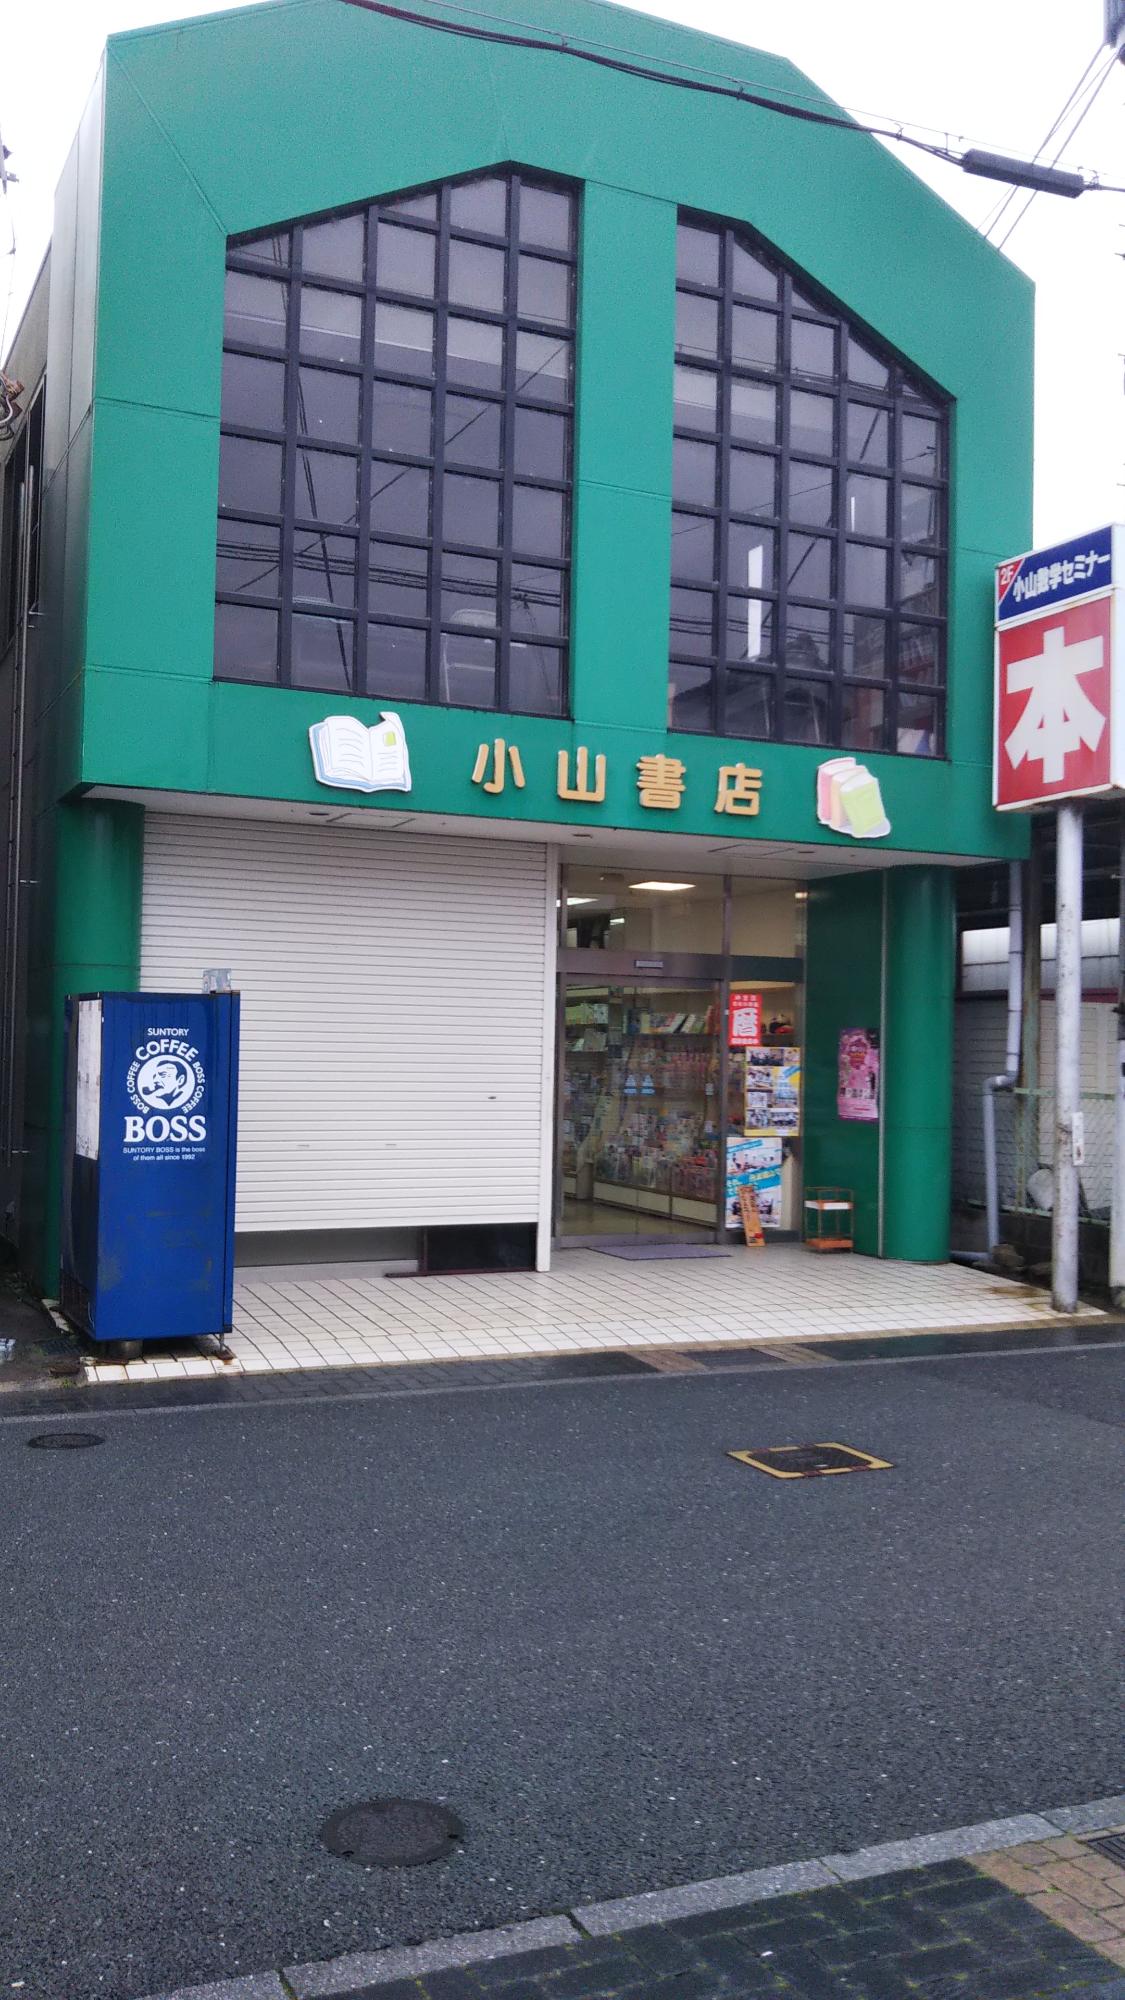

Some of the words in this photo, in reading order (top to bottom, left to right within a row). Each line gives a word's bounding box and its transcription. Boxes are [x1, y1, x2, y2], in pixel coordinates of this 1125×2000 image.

[1000, 565, 1014, 586] 2F
[1004, 626, 1106, 784] 本
[471, 738, 763, 816] 小山書店
[147, 1027, 190, 1036] SUNTORY
[135, 1038, 199, 1062] COFFEE
[126, 1060, 141, 1093] COFFEE
[192, 1061, 206, 1084] BOSS
[130, 1094, 150, 1114] BOSS
[181, 1085, 205, 1114] COFFEE
[123, 1115, 207, 1142] BOSS
